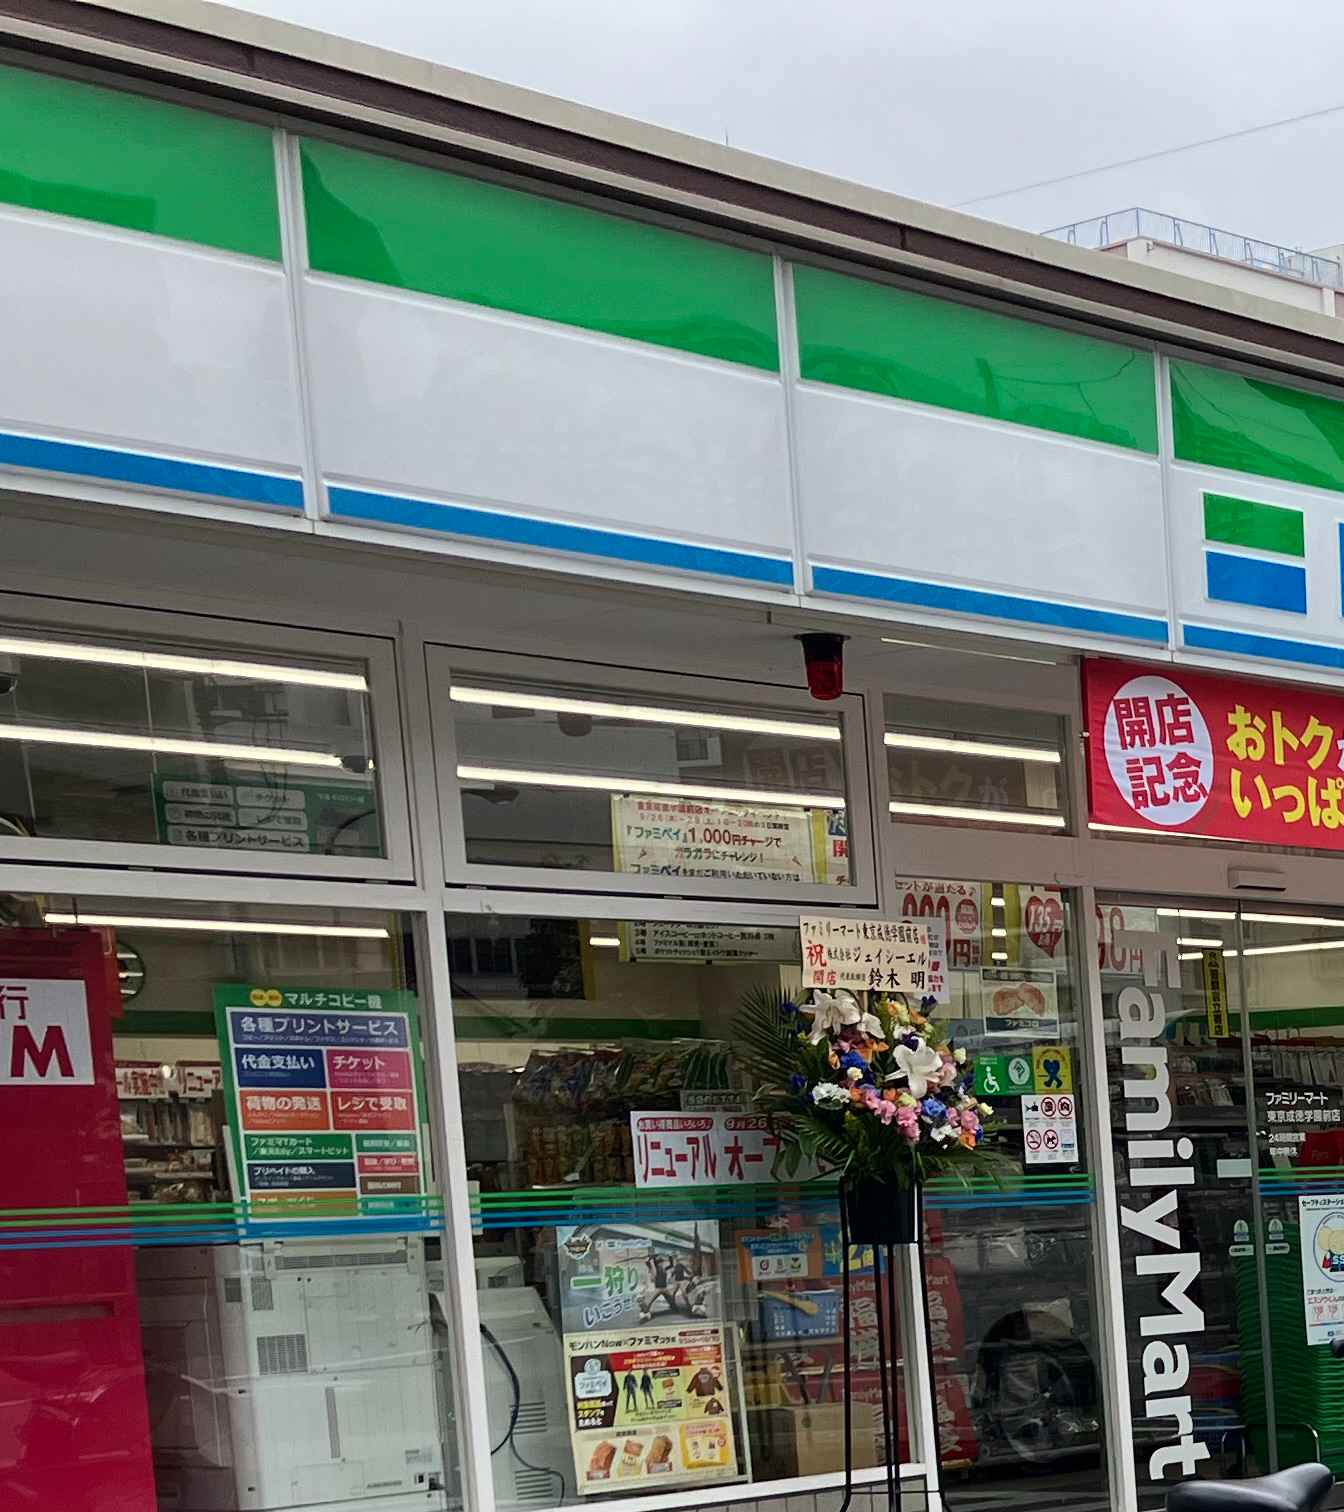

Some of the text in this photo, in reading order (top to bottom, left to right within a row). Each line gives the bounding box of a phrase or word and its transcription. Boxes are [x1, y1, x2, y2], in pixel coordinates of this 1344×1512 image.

[1112, 692, 1194, 750] 開店
[1125, 750, 1210, 808] 記念
[805, 939, 828, 968] 祝
[812, 968, 838, 986] 開店
[867, 967, 901, 989] 鈴木
[910, 970, 926, 990] 明
[284, 991, 383, 1010] マルチコピー機
[240, 1016, 399, 1036] 各種プリントサービス
[241, 1054, 316, 1070] 代金支払い
[332, 1055, 386, 1070] チケット
[246, 1095, 321, 1112] 荷物の発送
[337, 1095, 408, 1112] レジで受取
[1264, 1091, 1329, 1106] ファミリーマート
[637, 1132, 718, 1184] リニューアル
[1118, 930, 1212, 1482] FamilyMart
